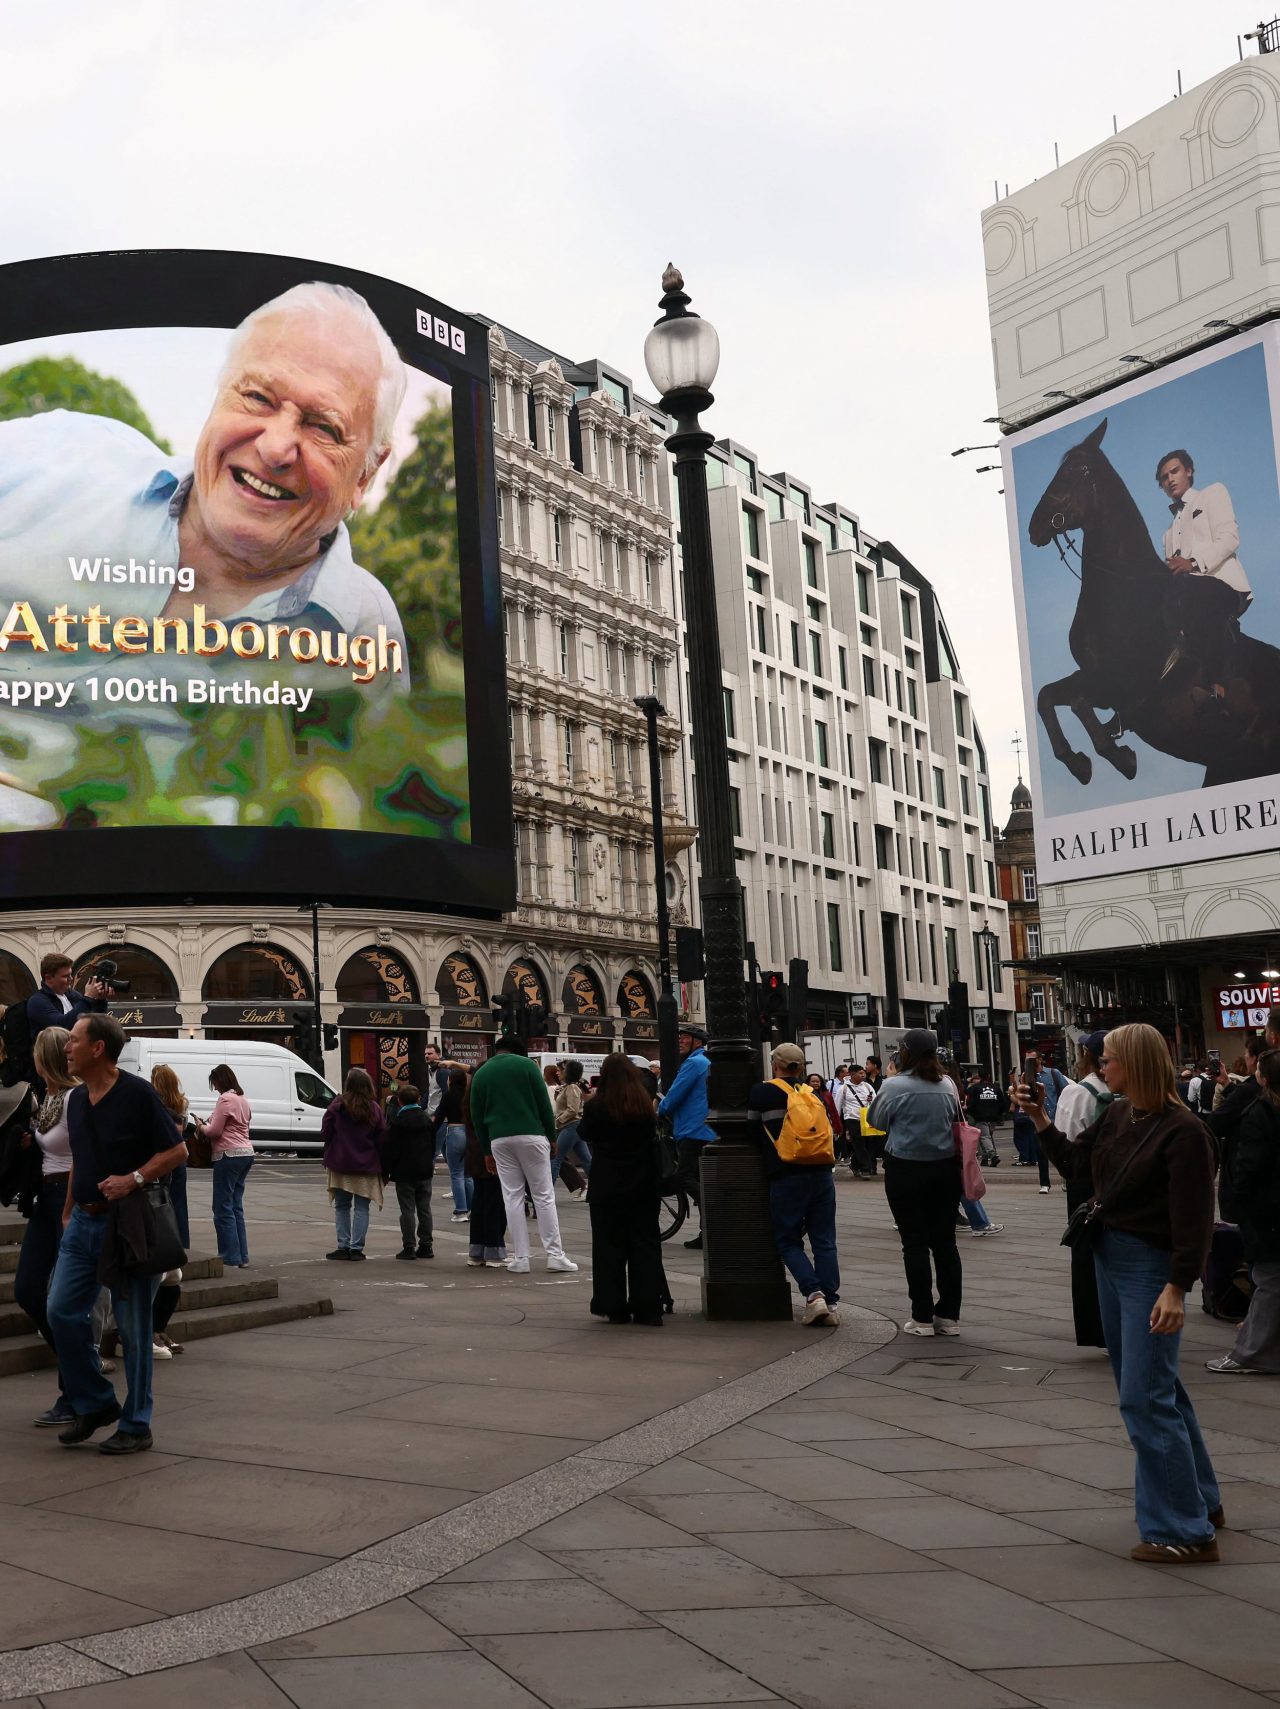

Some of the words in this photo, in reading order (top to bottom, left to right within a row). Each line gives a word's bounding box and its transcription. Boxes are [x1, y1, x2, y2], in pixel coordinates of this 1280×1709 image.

[416, 308, 466, 356] BBC
[67, 556, 196, 593] Wishing
[84, 675, 178, 704] 100th
[187, 678, 314, 712] Birthday
[1051, 821, 1149, 862] RALPH
[1165, 799, 1278, 843] LAURE
[1220, 986, 1280, 1006] SOUVE
[238, 1008, 276, 1023] Lindt
[366, 1010, 399, 1024] Lindt
[458, 1014, 479, 1027] Lindt
